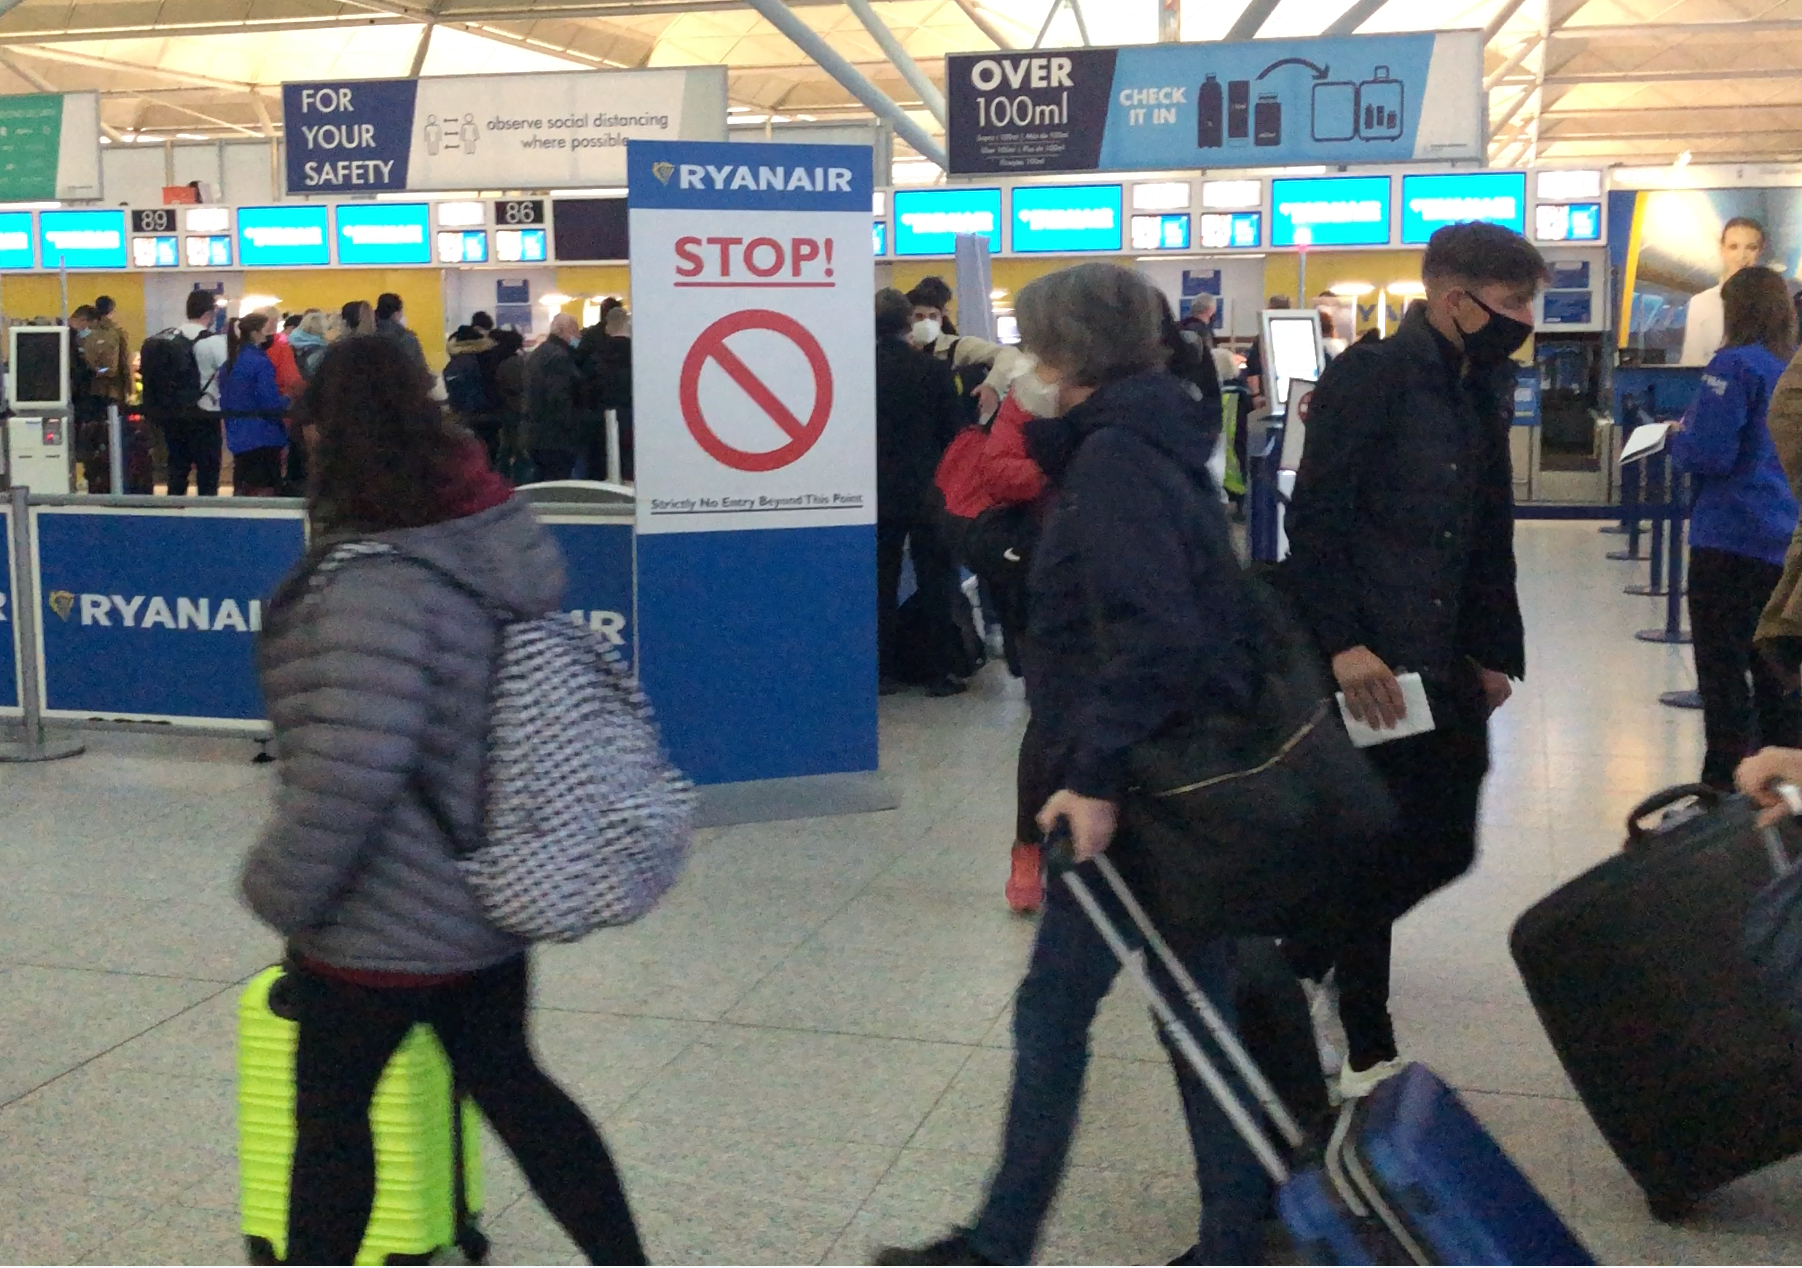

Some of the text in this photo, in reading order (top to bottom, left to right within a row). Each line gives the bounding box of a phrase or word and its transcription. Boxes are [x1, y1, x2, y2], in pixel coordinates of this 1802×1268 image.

[971, 57, 1074, 91] OVER
[301, 88, 355, 113] FOR
[976, 91, 1068, 127] 100ml
[1119, 86, 1187, 107] CHECK
[487, 111, 669, 131] observe social distancing
[1129, 107, 1177, 126] IT IN
[301, 124, 377, 149] YOUR
[521, 132, 629, 151] where possible
[304, 160, 395, 186] SAFETY
[679, 163, 852, 192] RYANAIR
[141, 210, 168, 231] 89
[506, 201, 535, 223] 86
[674, 236, 834, 278] STOP!
[650, 493, 863, 511] Strictly No Entry Beyond This Point
[80, 593, 263, 632] RYANAI
